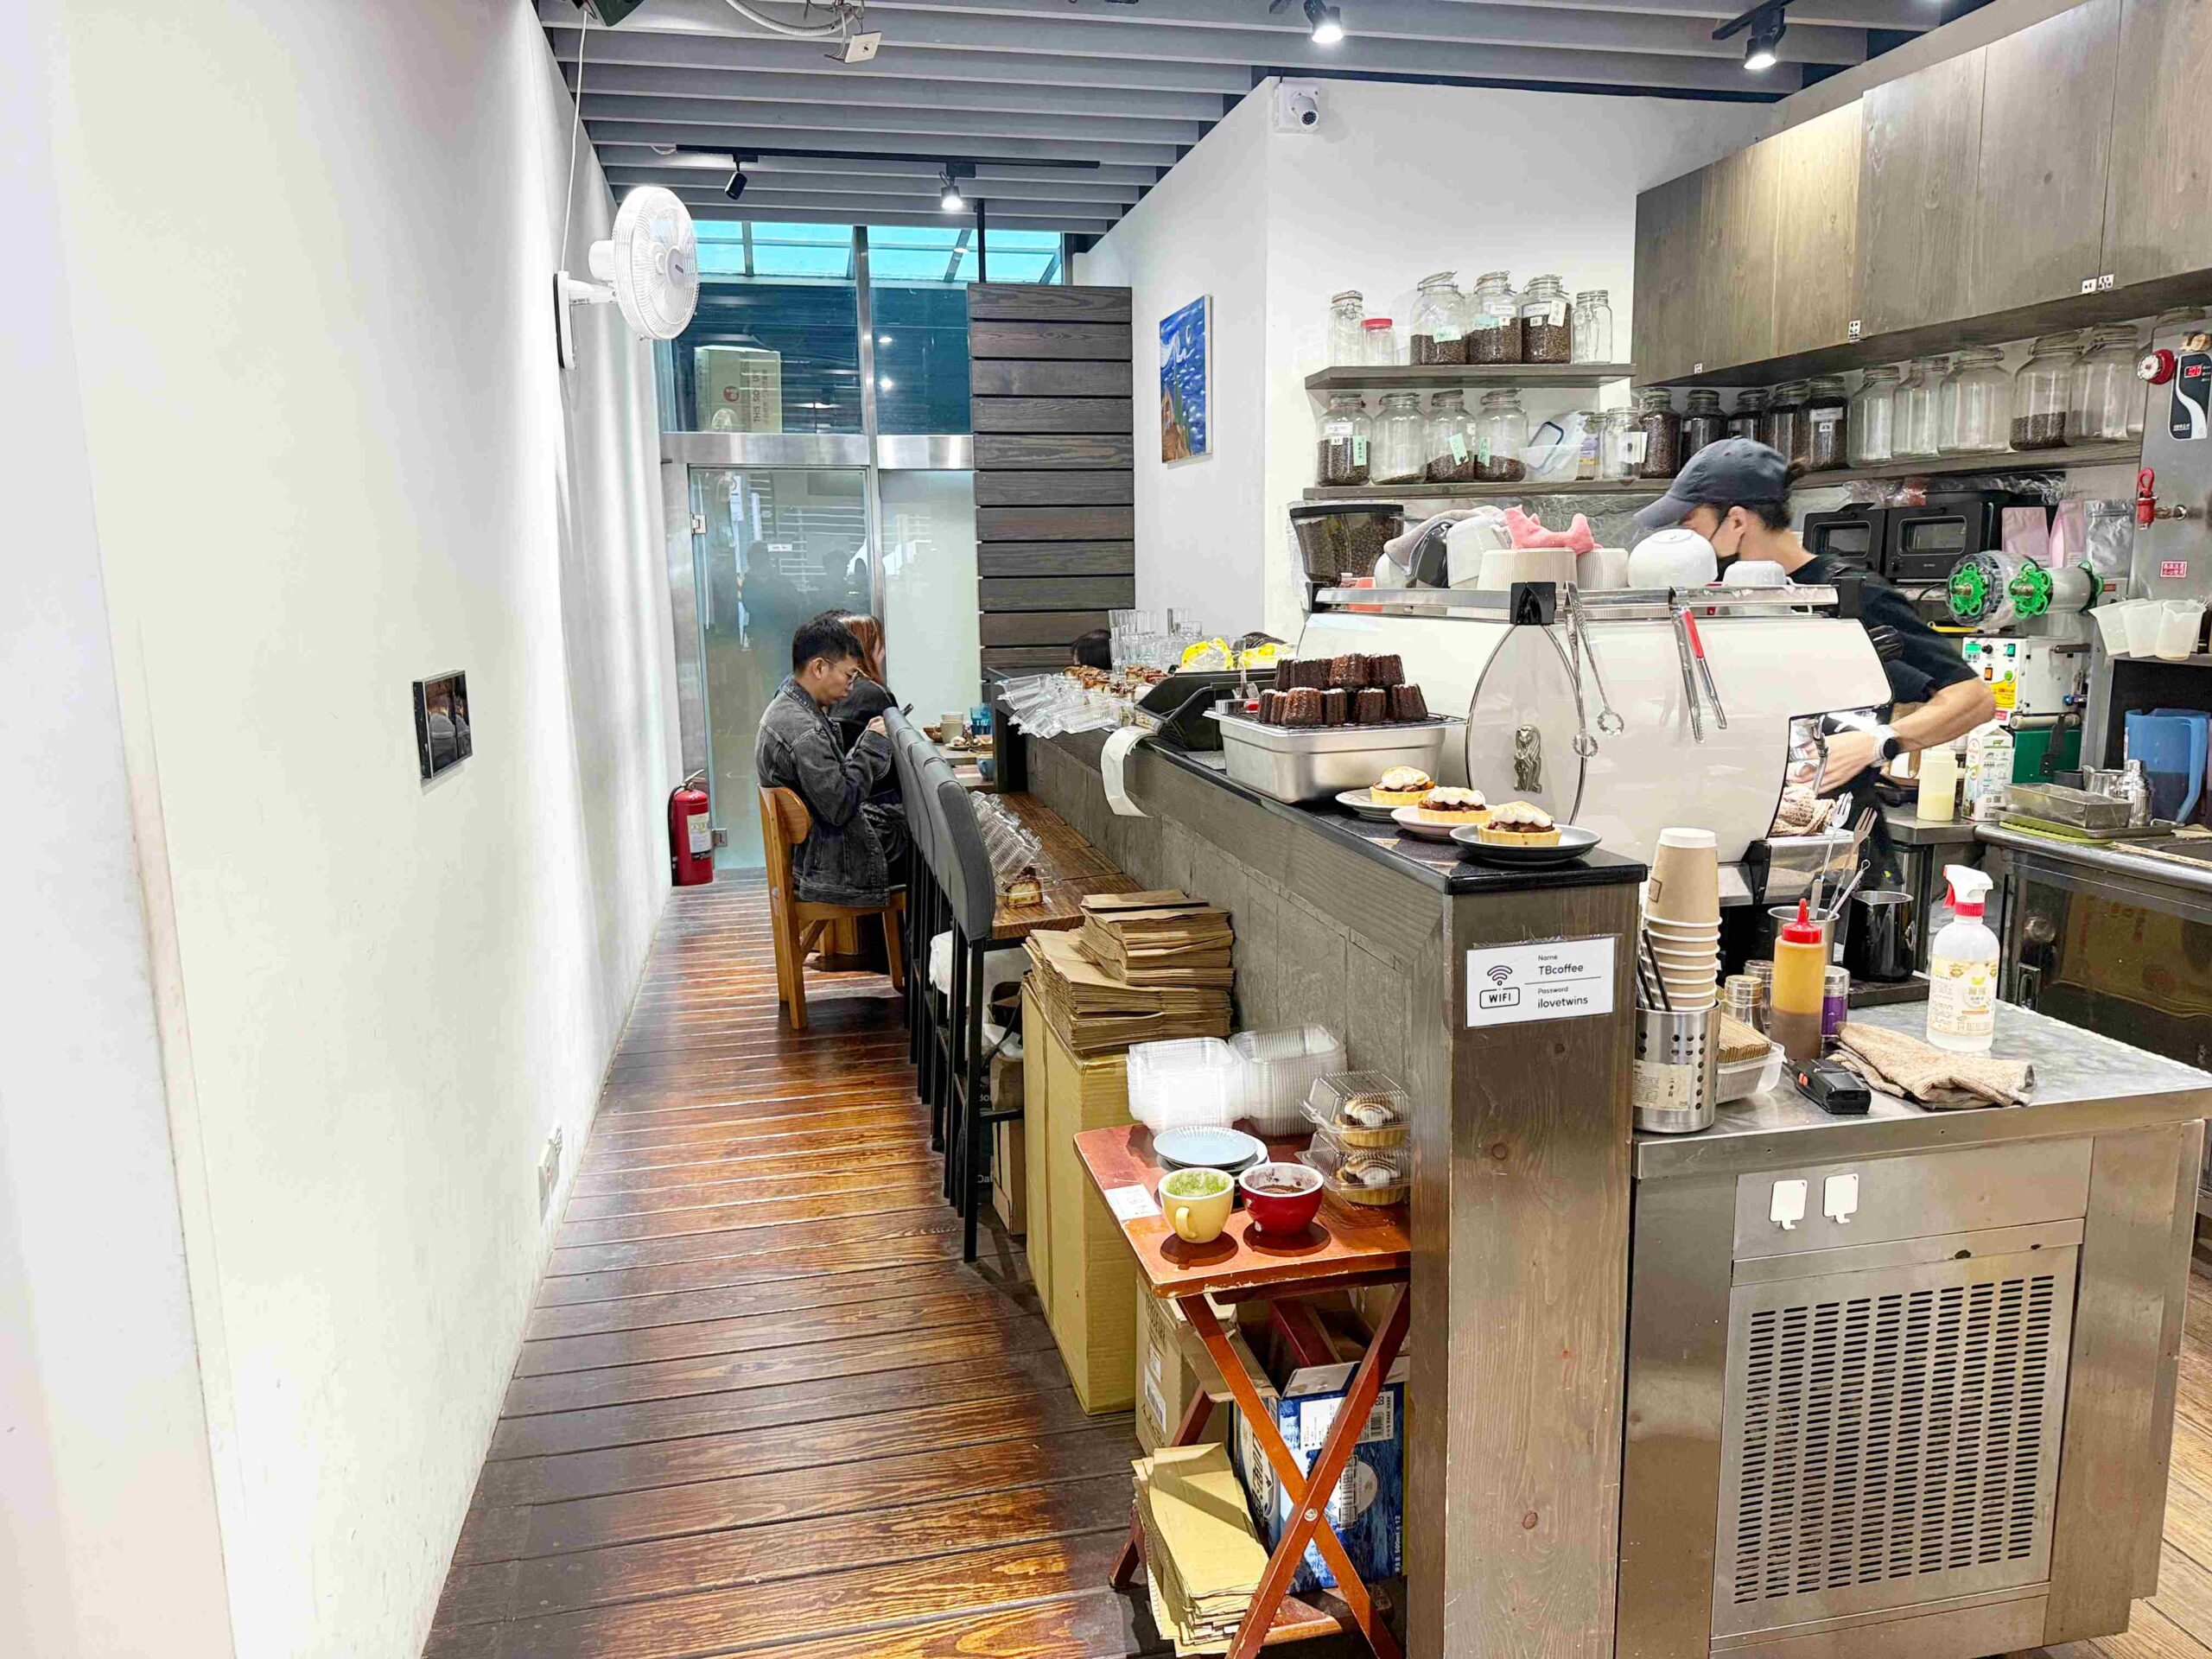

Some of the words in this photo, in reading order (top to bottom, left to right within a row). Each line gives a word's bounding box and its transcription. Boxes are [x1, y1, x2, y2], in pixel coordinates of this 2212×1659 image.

[1538, 963, 1584, 976] TBcoffee
[1538, 986, 1569, 995] Password
[1489, 993, 1511, 1003] WIFI
[1538, 996, 1589, 1009] ilovetwins
[1395, 1515, 1402, 1524] 12
